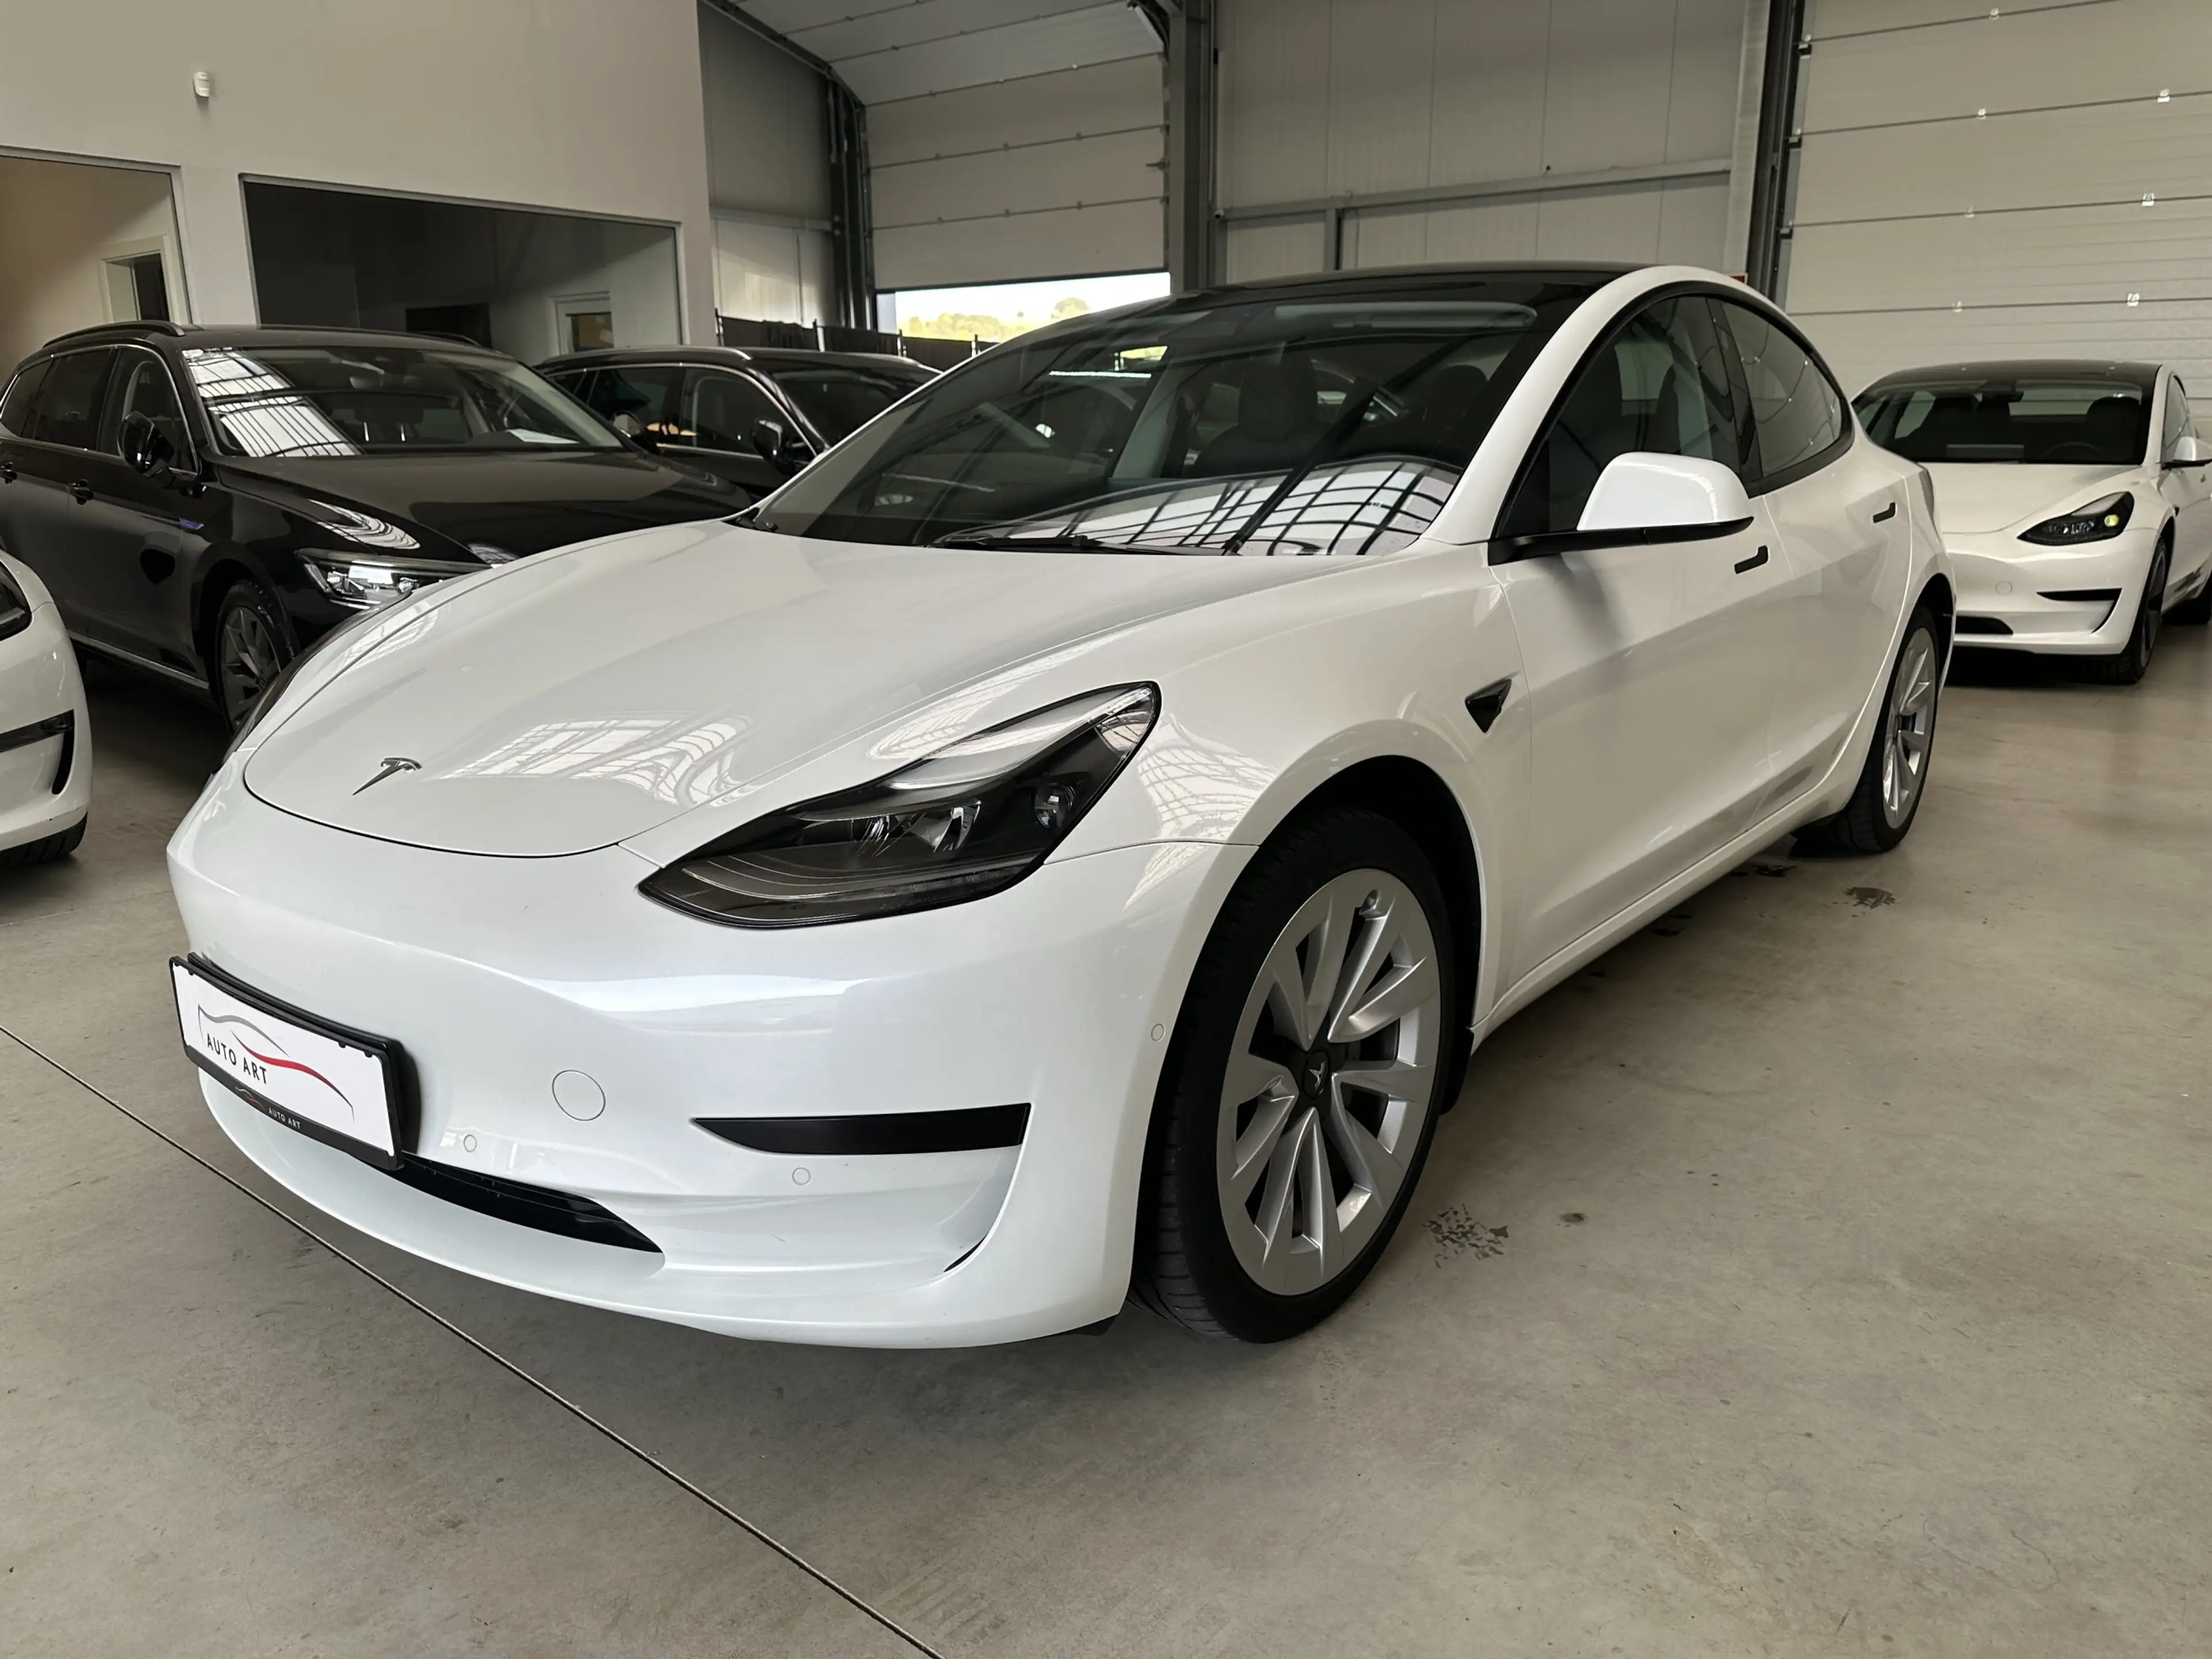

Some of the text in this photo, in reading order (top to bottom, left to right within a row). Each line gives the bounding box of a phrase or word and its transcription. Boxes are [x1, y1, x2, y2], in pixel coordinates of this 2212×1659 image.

[207, 1033, 267, 1084] AUTO ART
[268, 1107, 301, 1130] AUTO ART
